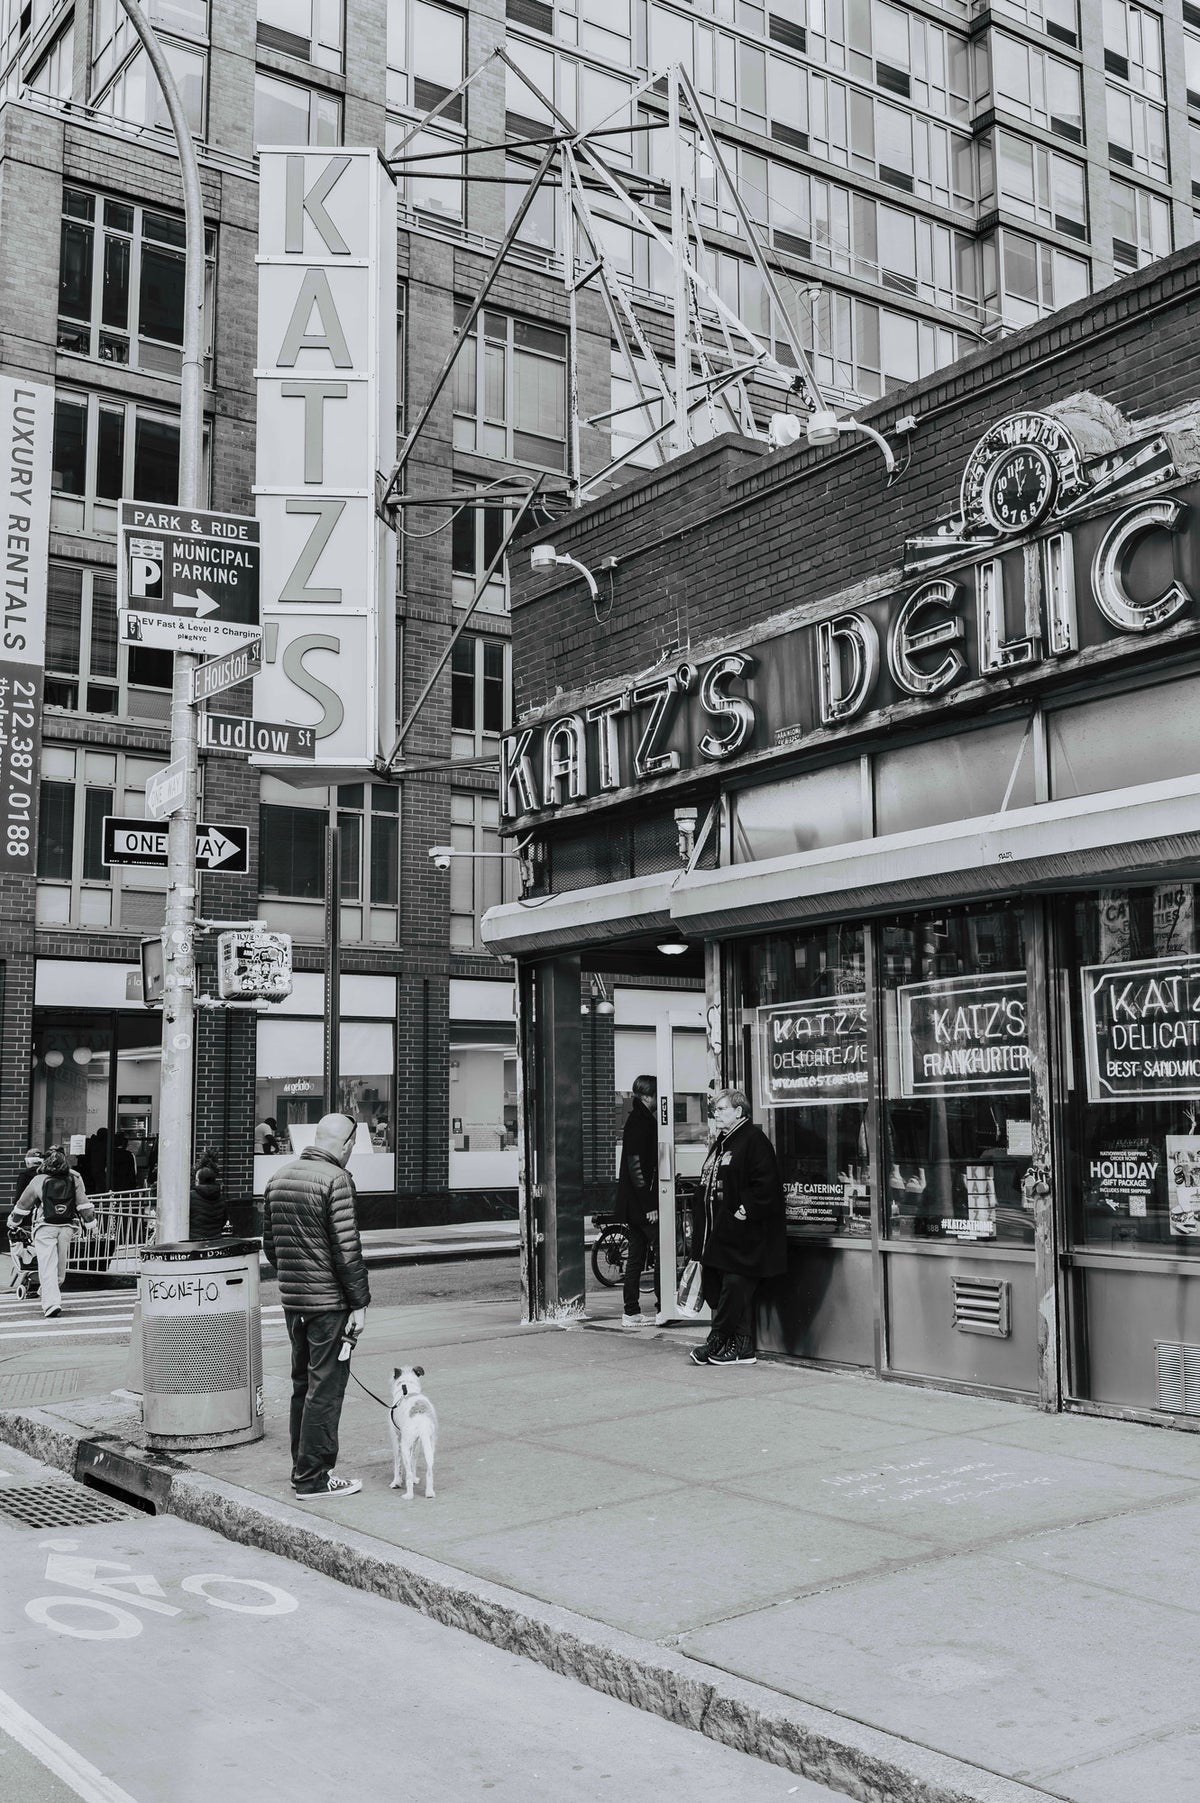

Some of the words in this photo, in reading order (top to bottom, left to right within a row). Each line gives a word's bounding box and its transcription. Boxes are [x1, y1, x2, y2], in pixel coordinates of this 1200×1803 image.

[10, 388, 36, 505] LUXURY
[264, 156, 353, 740] KATZ'S
[1015, 457, 1024, 471] 12
[1028, 456, 1033, 469] 1
[1035, 462, 1042, 475] 2
[1007, 464, 1015, 478] 11
[997, 477, 1007, 491] 10
[1039, 475, 1046, 488] 3
[997, 492, 1004, 505] 9
[1037, 490, 1044, 503] 4
[1001, 505, 1009, 518] 8
[1010, 510, 1017, 523] 7
[1020, 509, 1027, 523] 6
[1030, 502, 1036, 516] 5
[134, 511, 180, 530] PARK
[191, 519, 202, 533] &
[211, 521, 249, 540] RIDE
[173, 543, 253, 568] MUNICIPAL
[131, 557, 161, 596] P
[173, 562, 238, 585] PARKING
[3, 513, 31, 651] RENTALS
[142, 617, 154, 626] EV
[157, 620, 176, 629] Fast
[179, 622, 184, 630] &
[188, 624, 210, 633] Level
[195, 670, 200, 697] E
[205, 653, 248, 692] Houston
[252, 641, 260, 661] St
[208, 718, 289, 753] Ludlow
[298, 730, 311, 747] St
[500, 651, 757, 817] KATZ'S
[7, 680, 36, 856] 212.387.0188
[126, 834, 166, 853] ONE
[196, 838, 226, 857] AY
[934, 997, 1025, 1043] KATZ'S
[1113, 1020, 1200, 1050] DELICAT
[1107, 1061, 1140, 1077] BEST
[1090, 1161, 1159, 1180] HOLIDAY
[783, 1182, 803, 1192] STATE
[804, 1183, 844, 1194] CATERING!
[1118, 1179, 1147, 1187] PACKAGE
[941, 1218, 994, 1232] #KATZSATHOME
